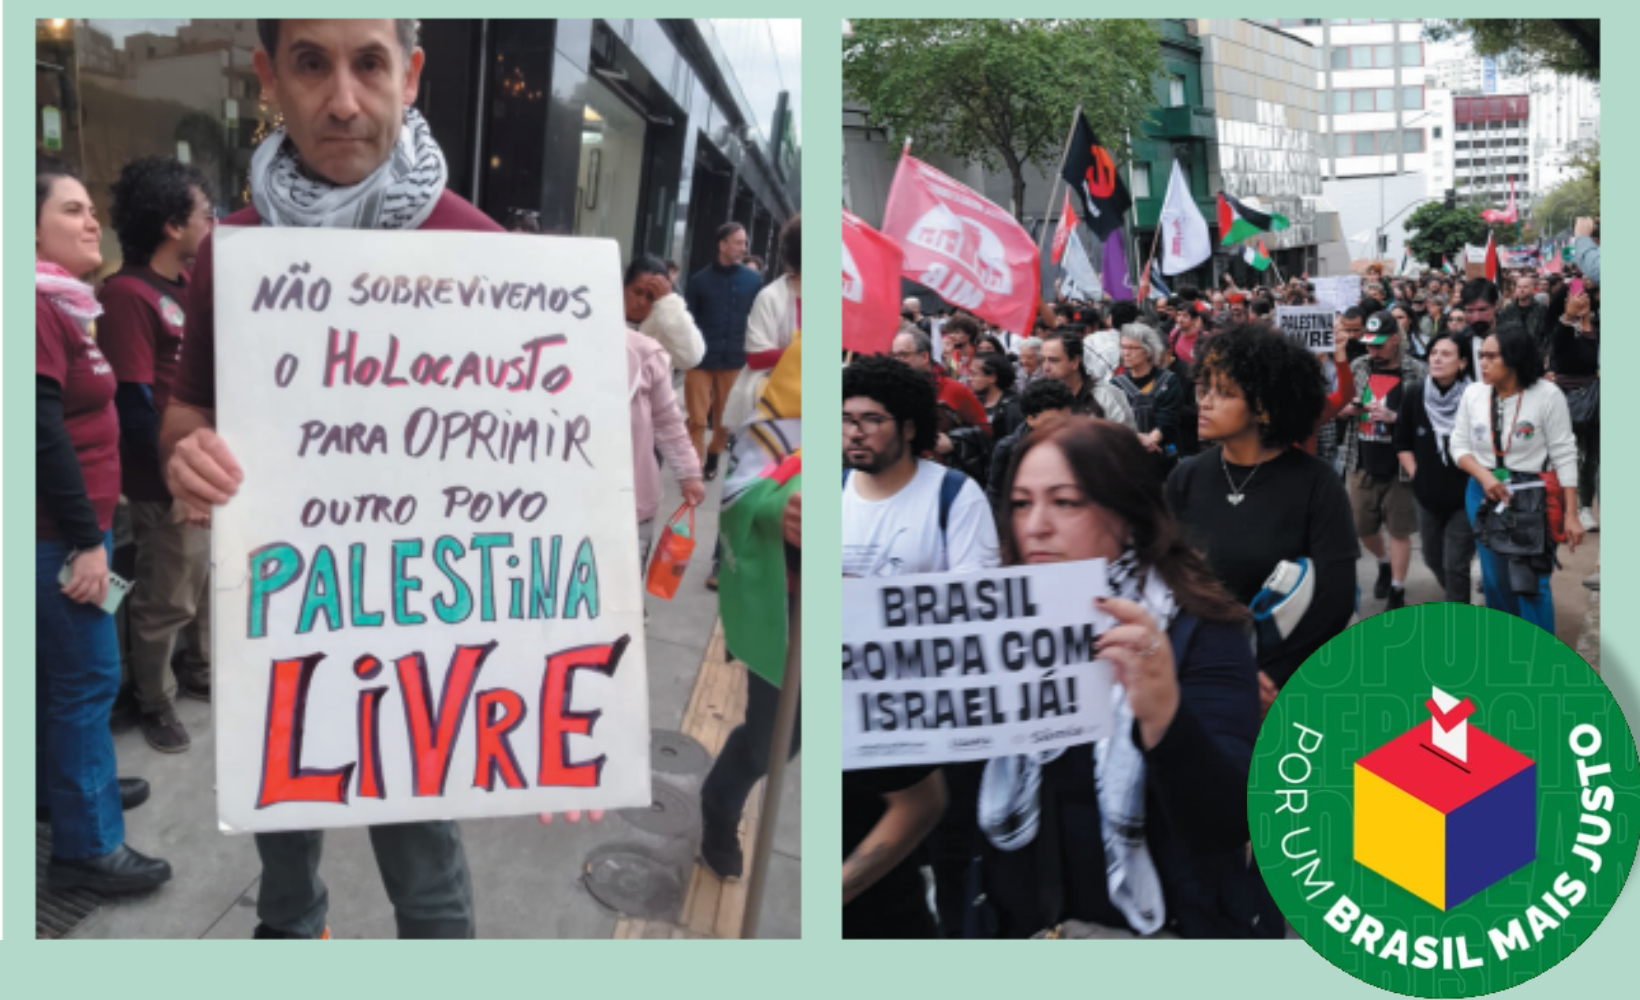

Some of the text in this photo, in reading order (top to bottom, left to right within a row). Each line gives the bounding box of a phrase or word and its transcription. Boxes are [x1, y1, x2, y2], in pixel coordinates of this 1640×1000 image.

[251, 262, 332, 312] NÃO
[274, 353, 299, 388] O
[297, 420, 388, 457] PARA
[300, 486, 547, 528] OUTRO POVO
[881, 576, 1037, 628] BRASIL
[1001, 623, 1096, 673] COM
[861, 667, 1078, 731] ISRAEL JÁ!
